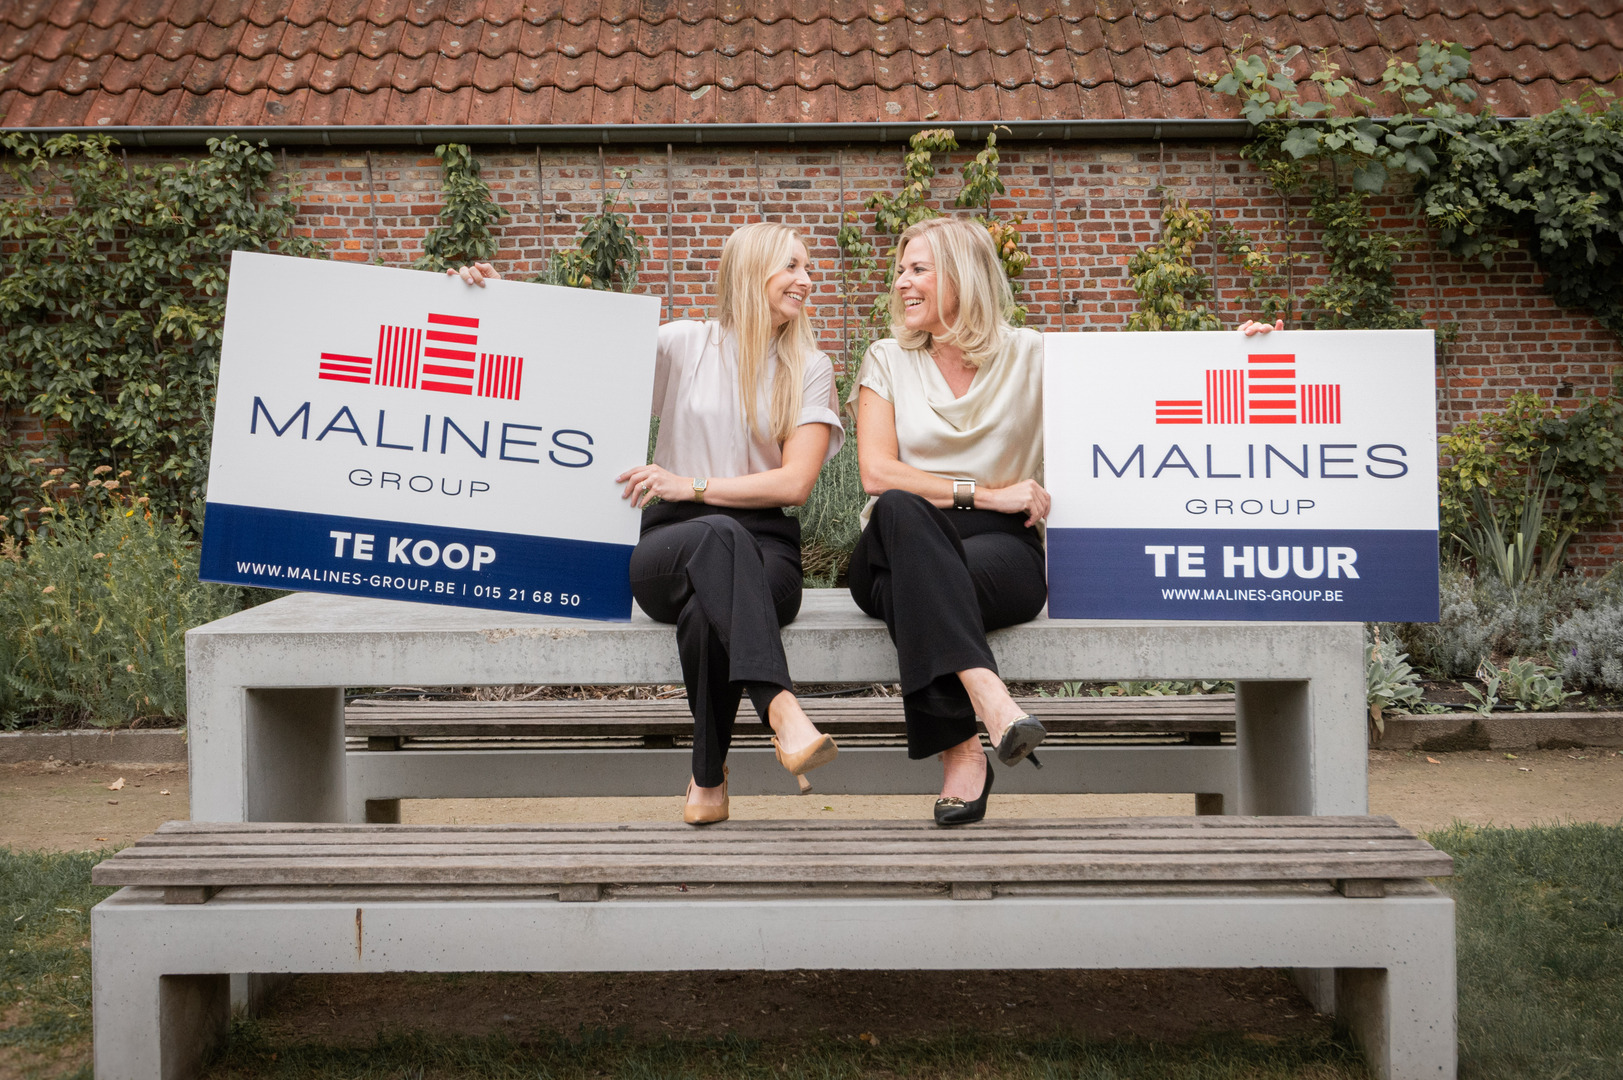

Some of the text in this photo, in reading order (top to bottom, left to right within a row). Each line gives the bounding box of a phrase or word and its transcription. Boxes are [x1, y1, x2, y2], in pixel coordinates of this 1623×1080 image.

[249, 395, 594, 469] MALINES
[1092, 443, 1409, 480] MALINES
[348, 468, 491, 498] GROUP
[1185, 498, 1316, 515] GROUP
[329, 530, 496, 572] TE KOOP
[1144, 544, 1361, 580] TE HUUR
[236, 561, 456, 595] WWW.MALINES-GROUP.BE
[473, 584, 501, 599] 015
[508, 588, 525, 601] 21
[532, 590, 553, 604] 68
[560, 593, 580, 607] 50
[1161, 588, 1344, 602] WWW.MALINES-GROUP.BE
